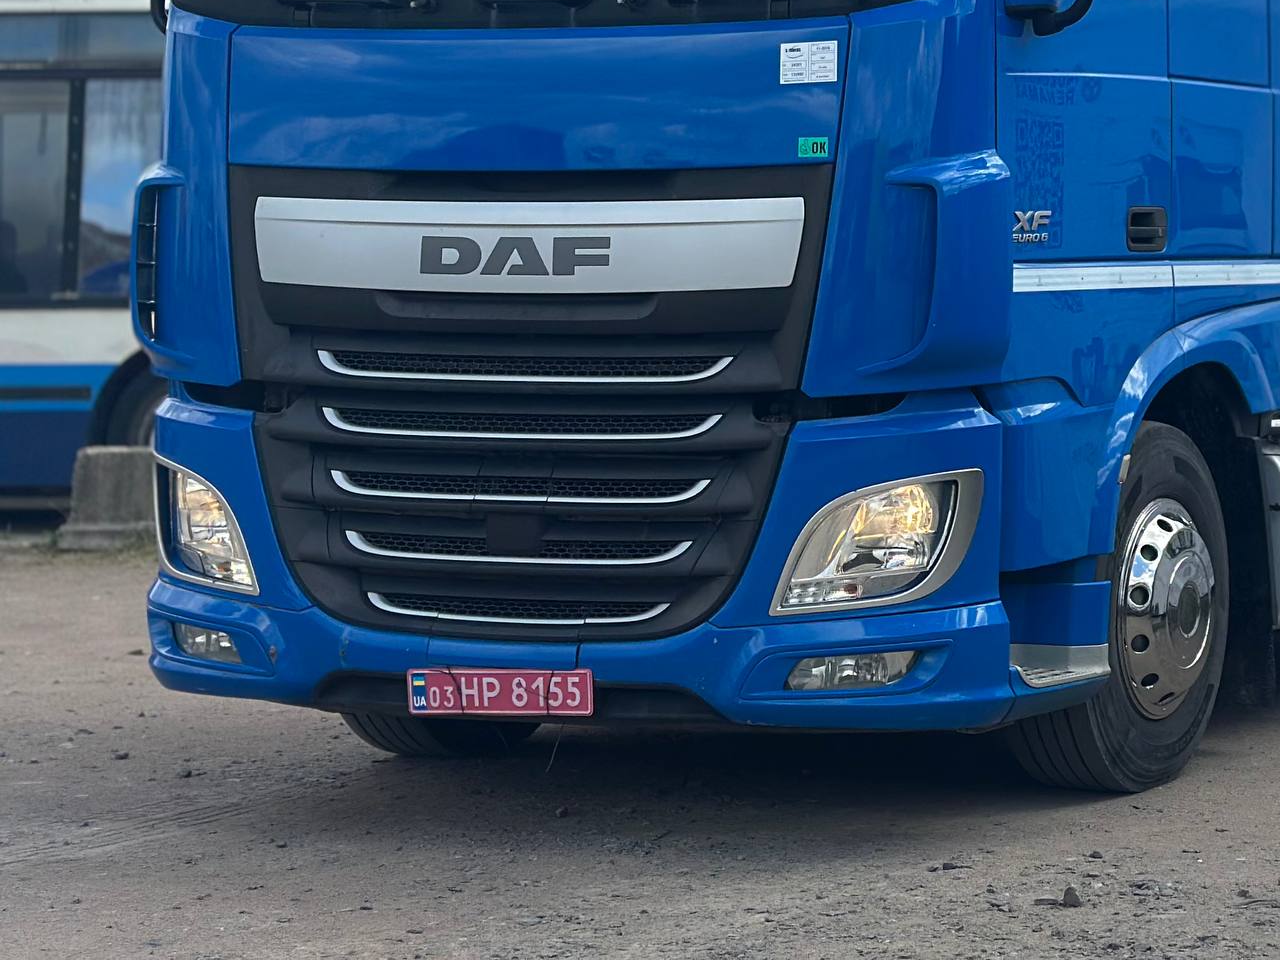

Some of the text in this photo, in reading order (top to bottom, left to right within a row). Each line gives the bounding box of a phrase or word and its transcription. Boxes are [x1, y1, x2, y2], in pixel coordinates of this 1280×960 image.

[811, 141, 827, 154] OK
[1012, 210, 1052, 231] XF
[420, 235, 611, 276] DAF
[414, 677, 581, 708] UA 03 HP 8155
